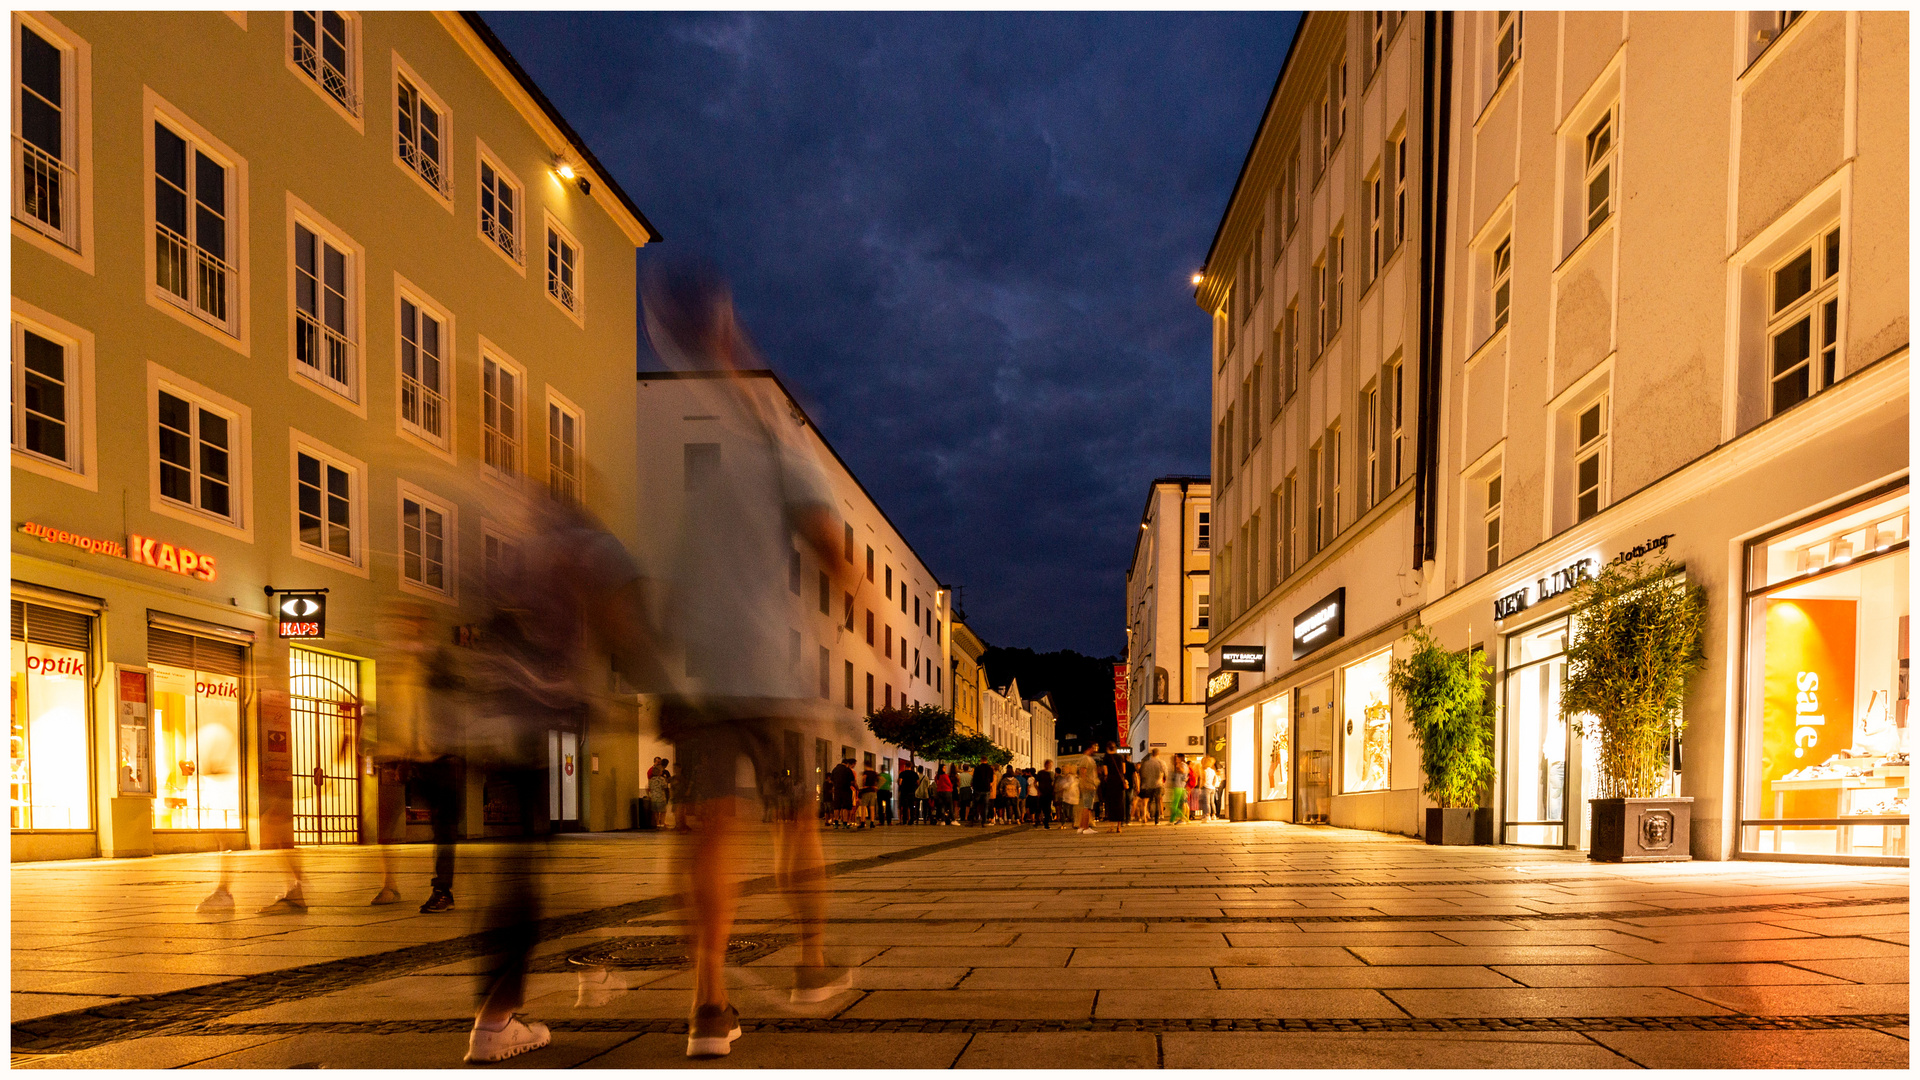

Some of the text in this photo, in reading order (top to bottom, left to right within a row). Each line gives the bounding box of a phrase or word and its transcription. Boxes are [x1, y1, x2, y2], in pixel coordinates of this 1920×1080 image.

[131, 534, 217, 582] KAPS
[1494, 557, 1594, 622] NEW LINE
[280, 622, 319, 636] KAPS
[27, 655, 85, 676] optik
[196, 681, 238, 698] optik
[1115, 670, 1128, 739] SALE SALE
[1794, 671, 1825, 758] sale.
